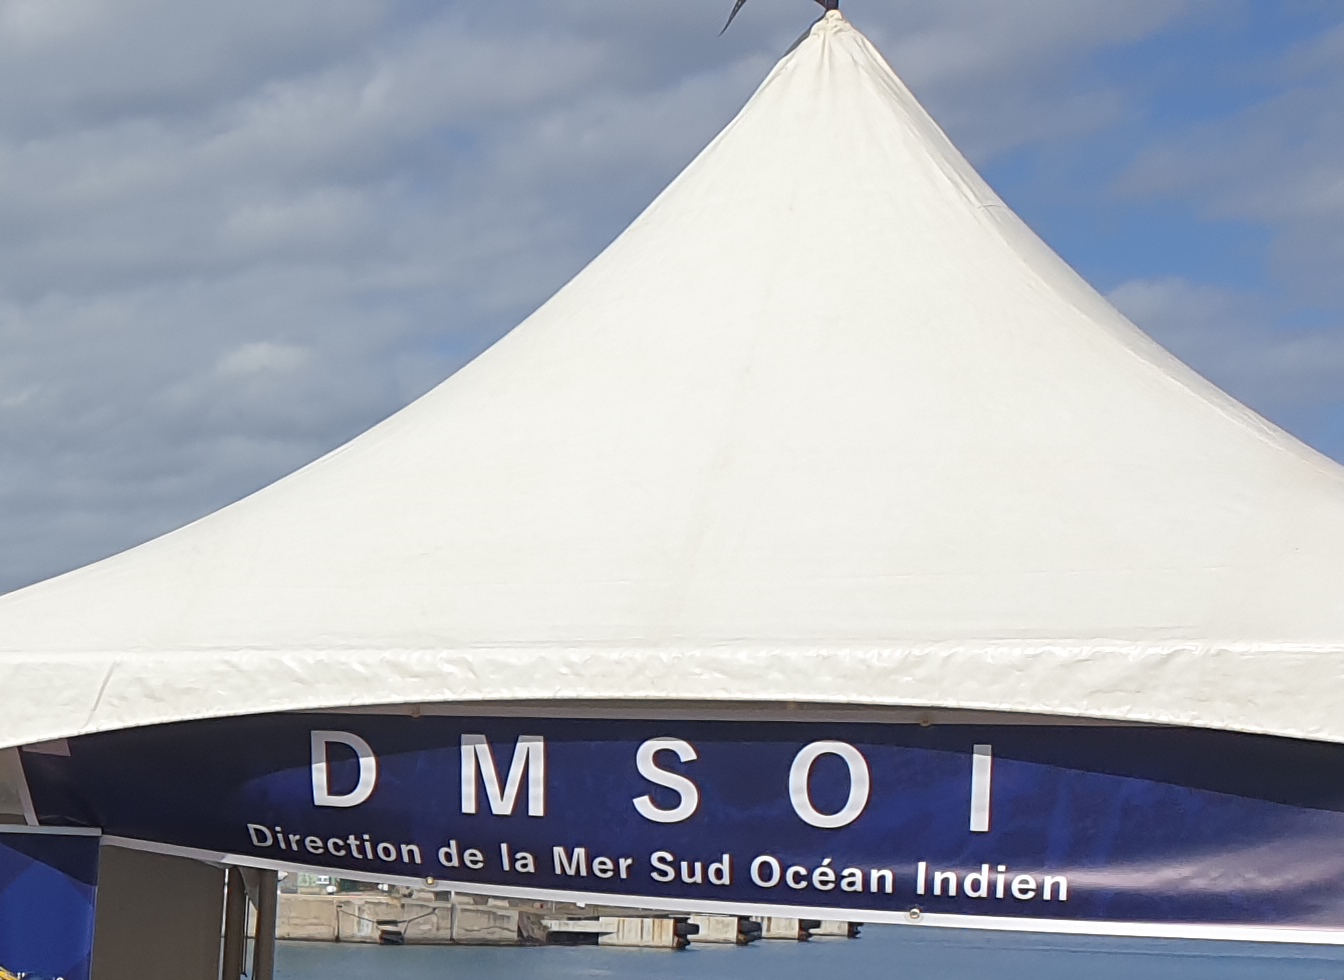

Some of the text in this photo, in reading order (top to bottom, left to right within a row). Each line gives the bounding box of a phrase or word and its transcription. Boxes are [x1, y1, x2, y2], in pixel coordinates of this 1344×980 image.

[247, 823, 1069, 902] Direction de la Mer Sud Océan Indien
